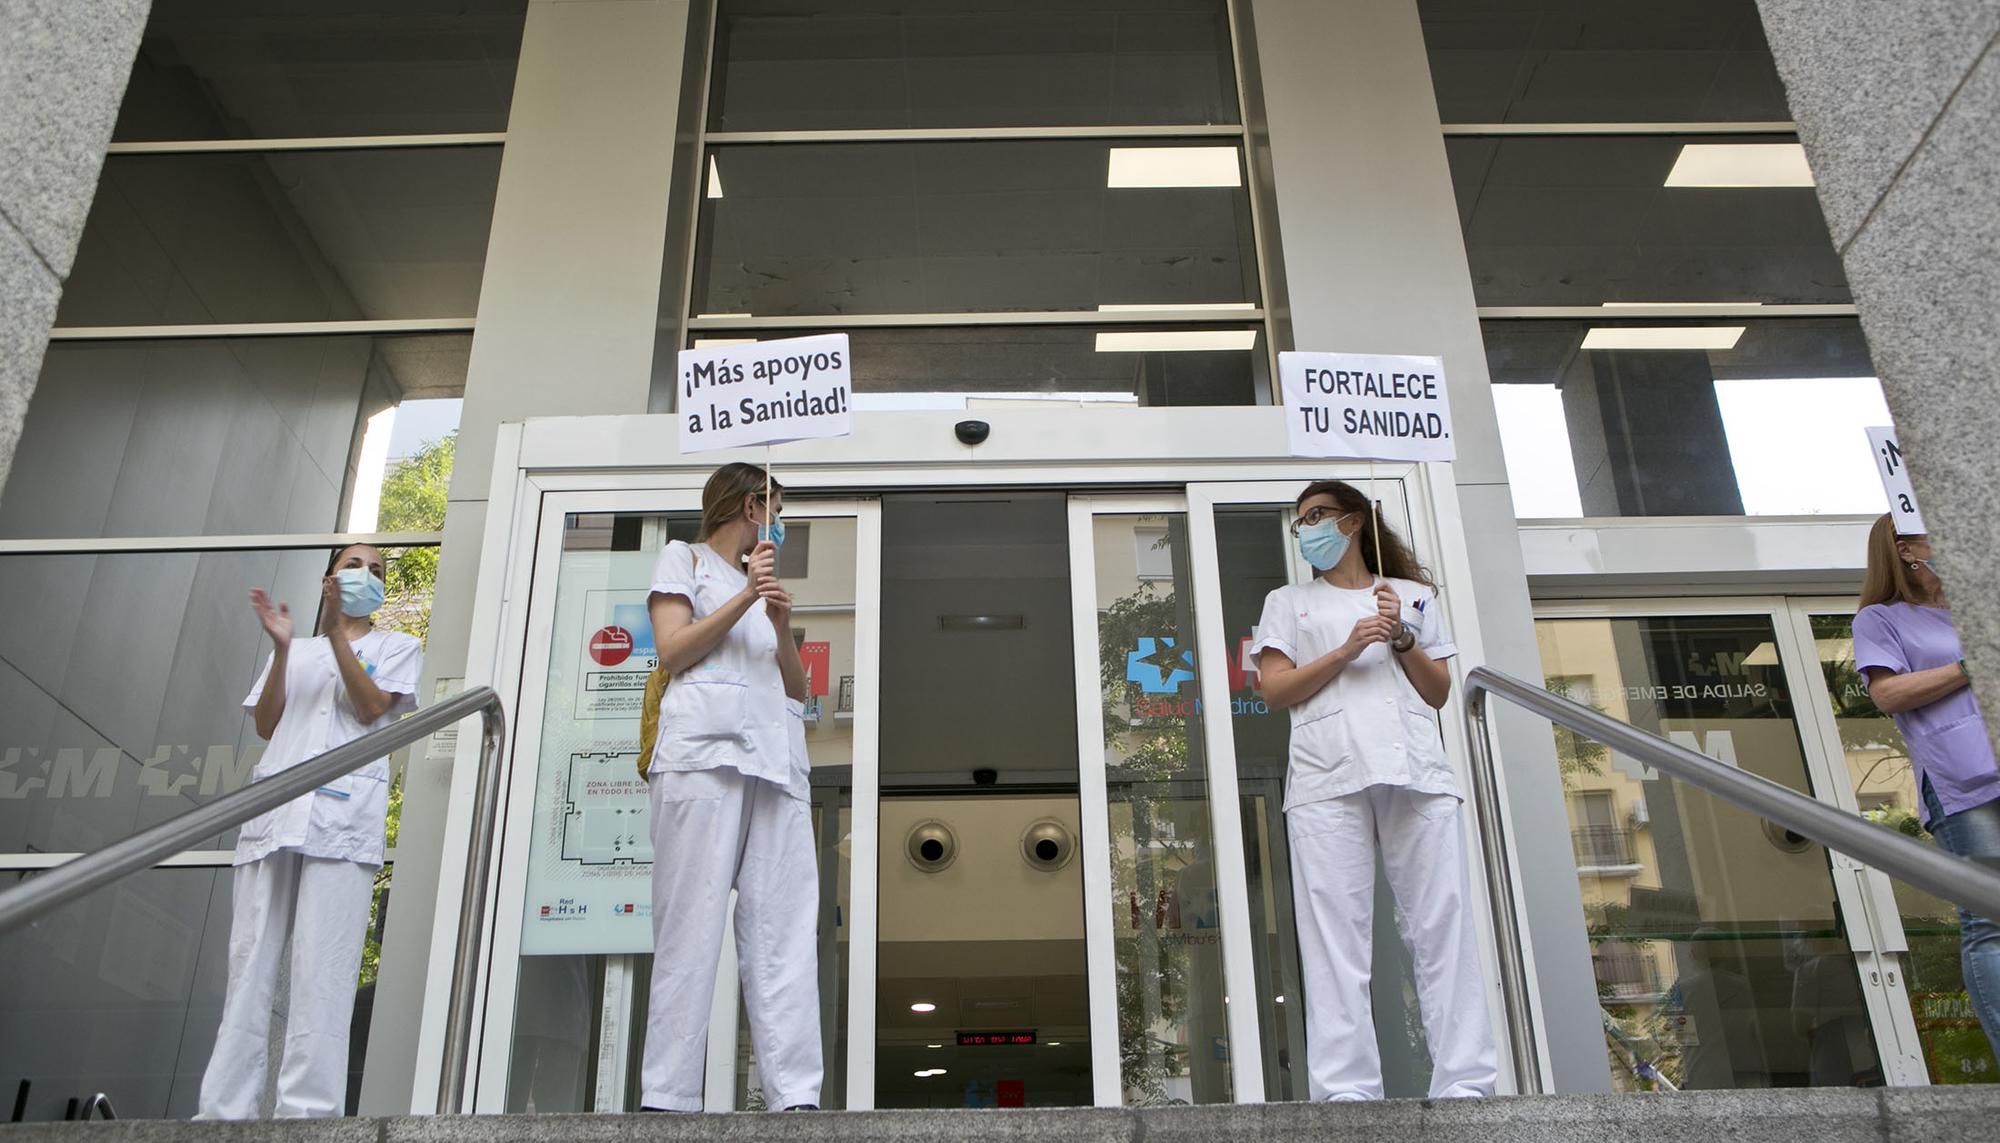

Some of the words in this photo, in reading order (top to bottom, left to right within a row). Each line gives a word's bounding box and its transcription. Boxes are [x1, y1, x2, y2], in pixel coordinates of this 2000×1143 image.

[685, 359, 744, 397] ¡Más
[752, 351, 842, 385] apoyos
[1305, 368, 1438, 400] FORTALECE
[688, 414, 703, 433] a
[710, 404, 733, 431] la
[739, 386, 848, 425] Sanidad!
[1300, 407, 1330, 433] TU
[1343, 407, 1449, 439] SANIDAD.
[1898, 493, 1915, 513] a
